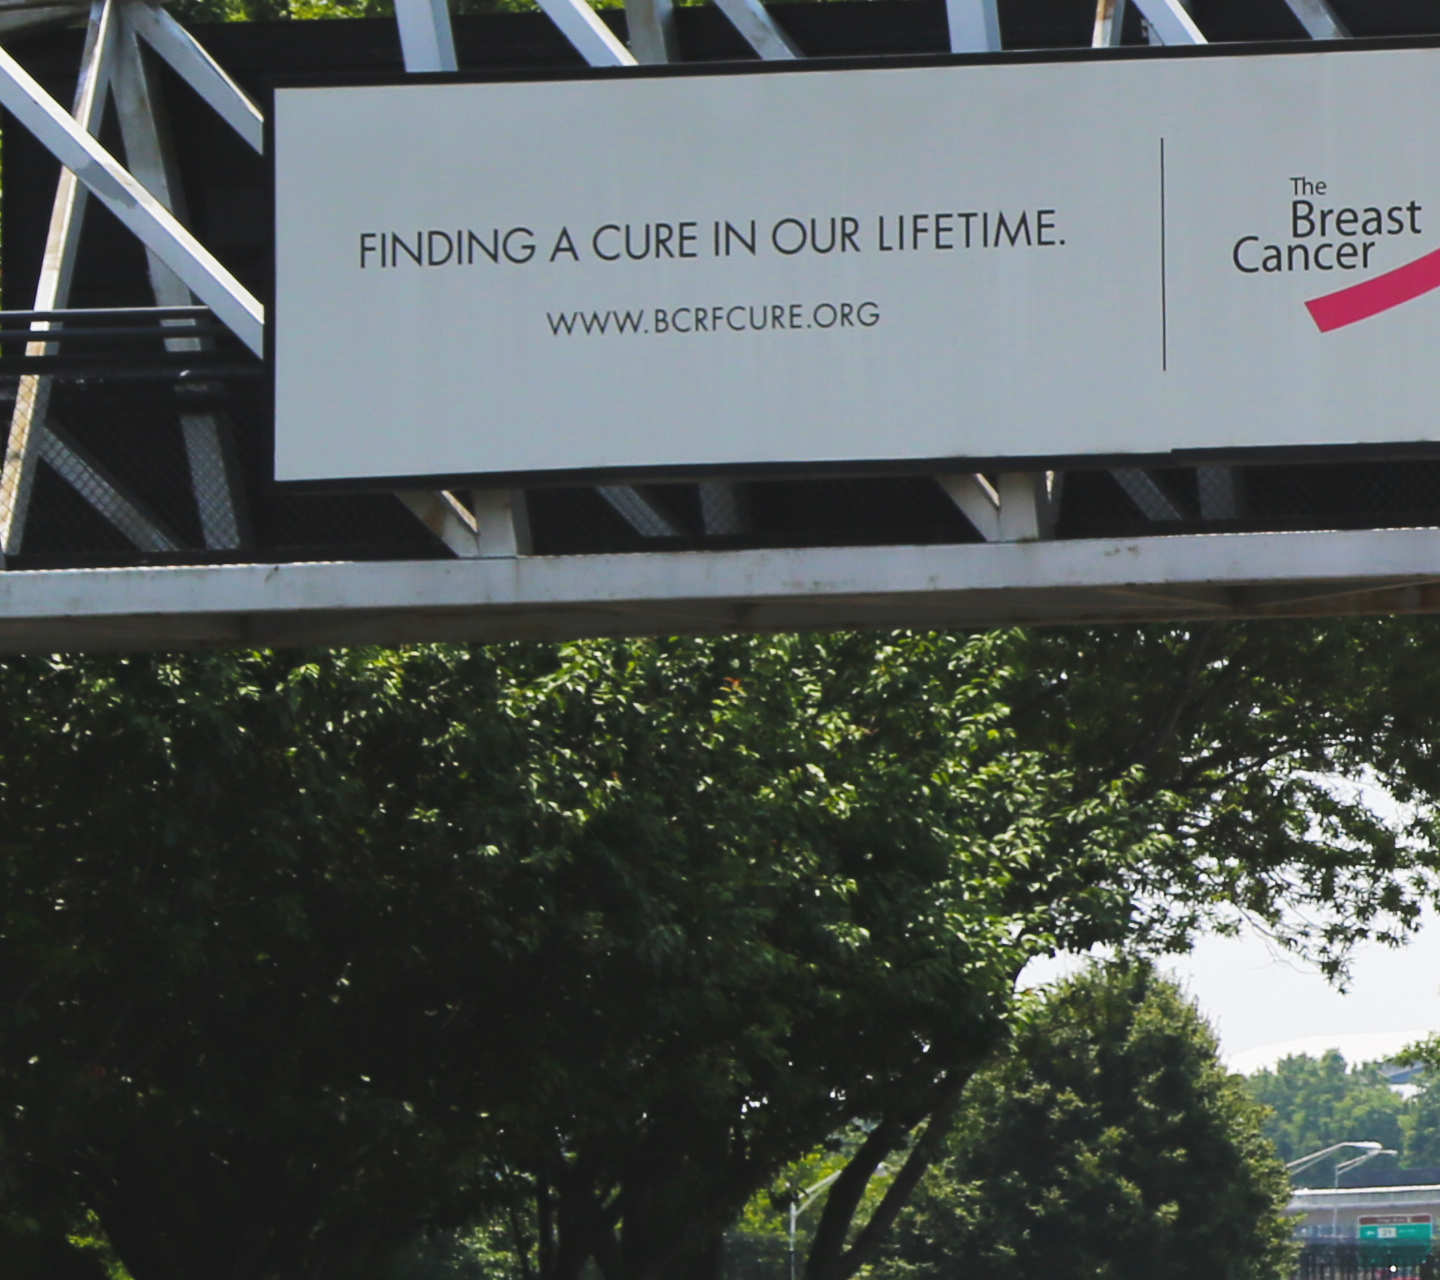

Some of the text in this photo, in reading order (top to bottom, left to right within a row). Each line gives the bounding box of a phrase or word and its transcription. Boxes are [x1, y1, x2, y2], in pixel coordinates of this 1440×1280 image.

[1291, 177, 1327, 196] The
[1292, 200, 1422, 238] Breast
[360, 209, 1066, 269] FINDING A CURE IN OUR LIFETIME.
[1233, 236, 1376, 273] Cancer
[546, 301, 880, 336] WWW.BCRFCURE.ORG
